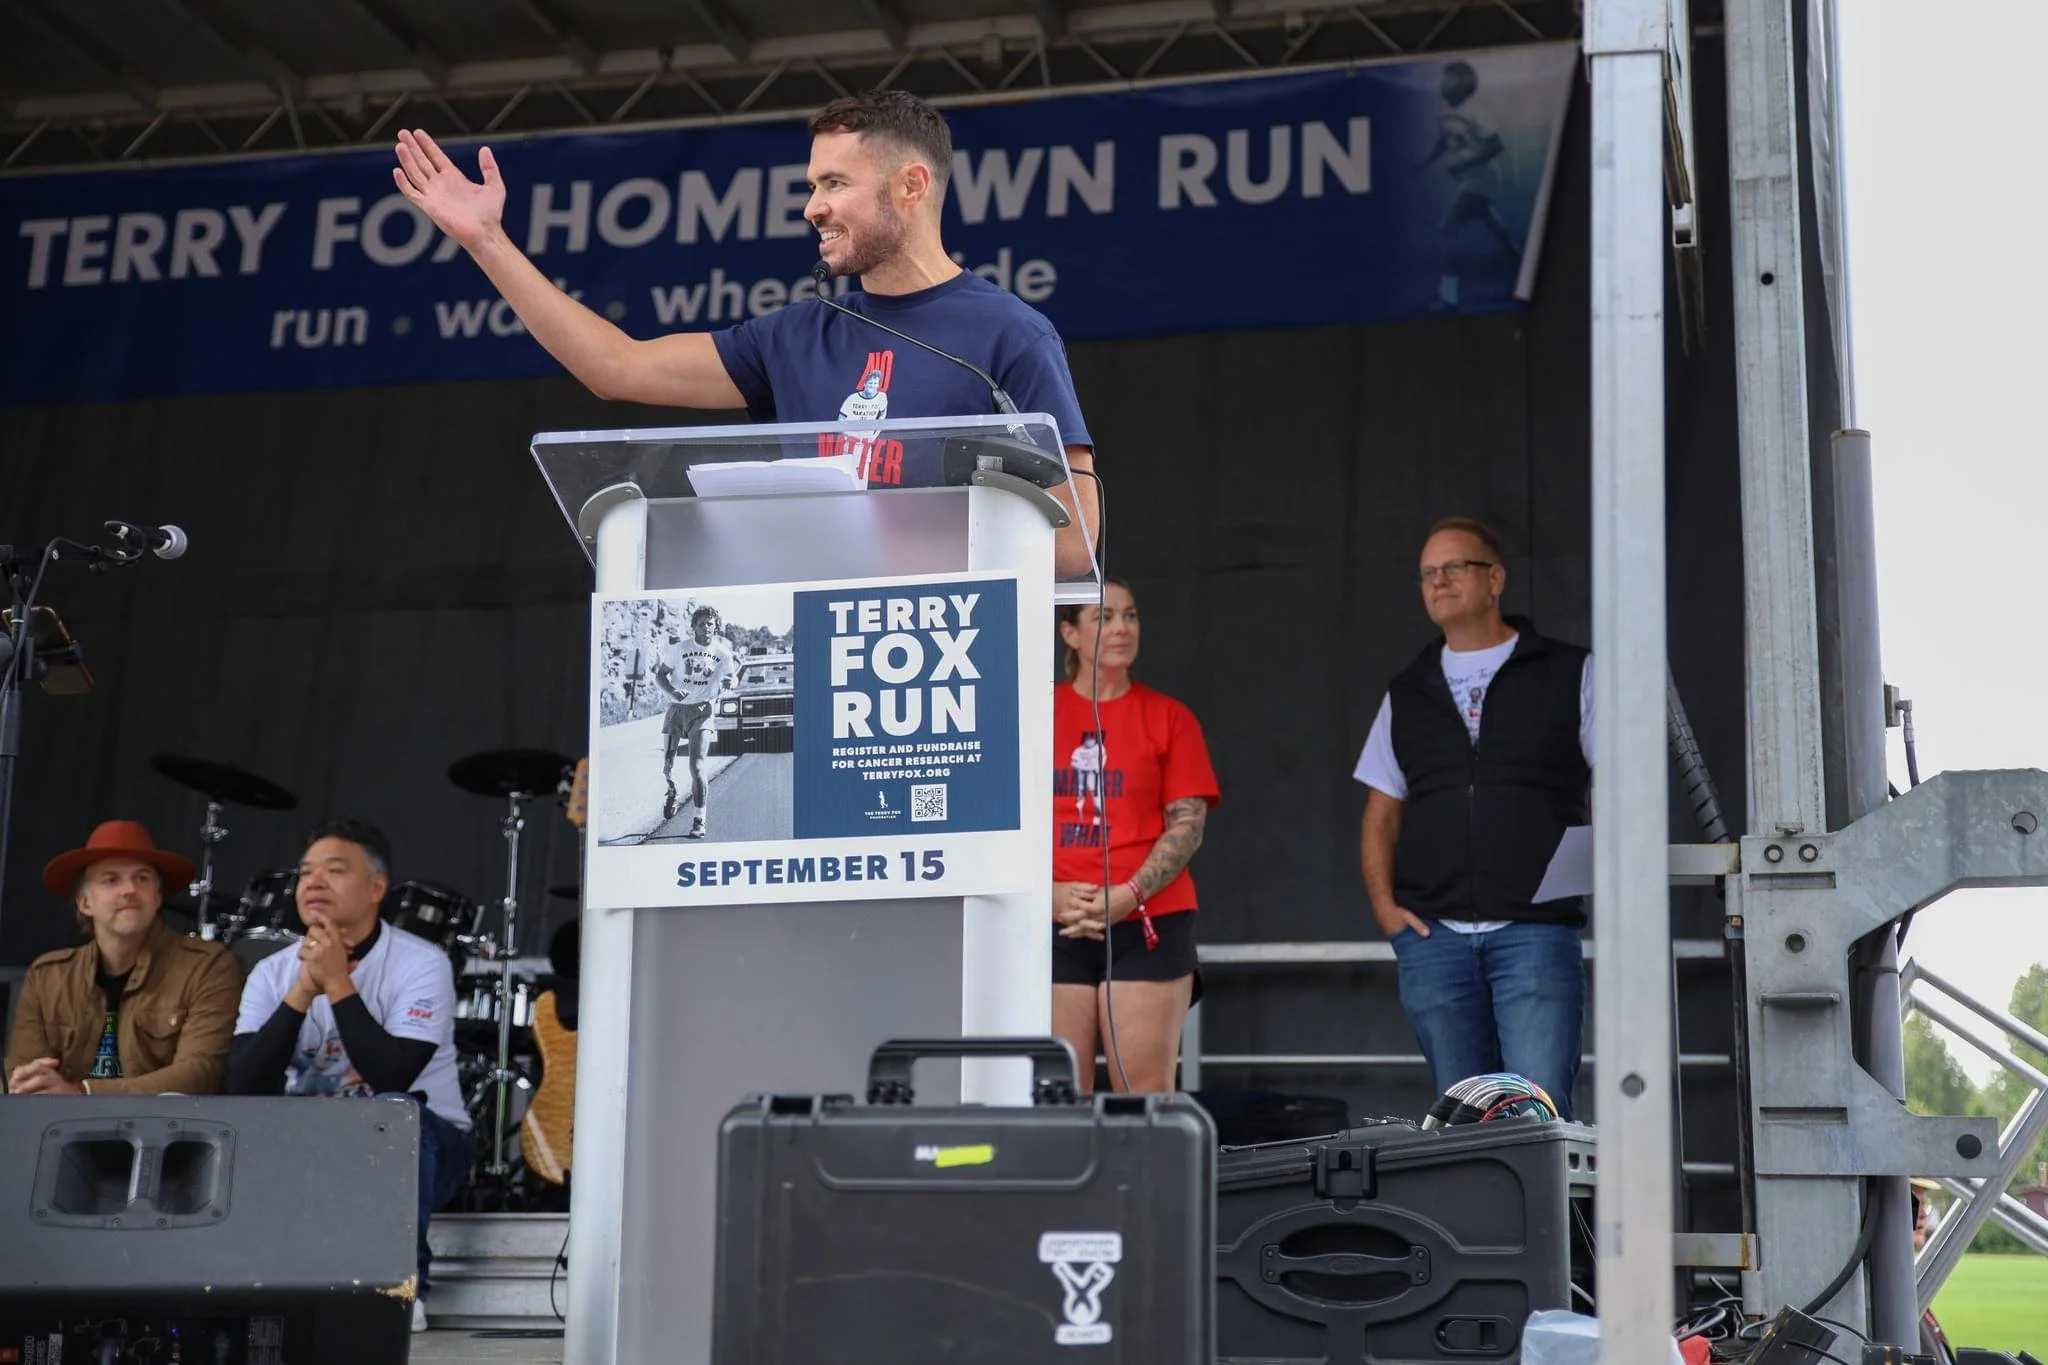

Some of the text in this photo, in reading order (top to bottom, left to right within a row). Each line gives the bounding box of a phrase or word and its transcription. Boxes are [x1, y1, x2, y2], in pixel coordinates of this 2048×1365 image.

[18, 116, 1372, 290] TERRY FO HOMEWN RUN
[270, 304, 369, 349] run
[829, 593, 981, 634] TERRY
[682, 651, 721, 663] MARATHON
[830, 628, 982, 687] FOX
[832, 684, 978, 739] RUN
[832, 741, 981, 757] REGISTER AND FUNDRAISE
[832, 753, 982, 769] FOR CANCER RESEARCH AT
[862, 768, 951, 781] TERRYFOX.ORG
[676, 850, 946, 888] SEPTEMBER 15
